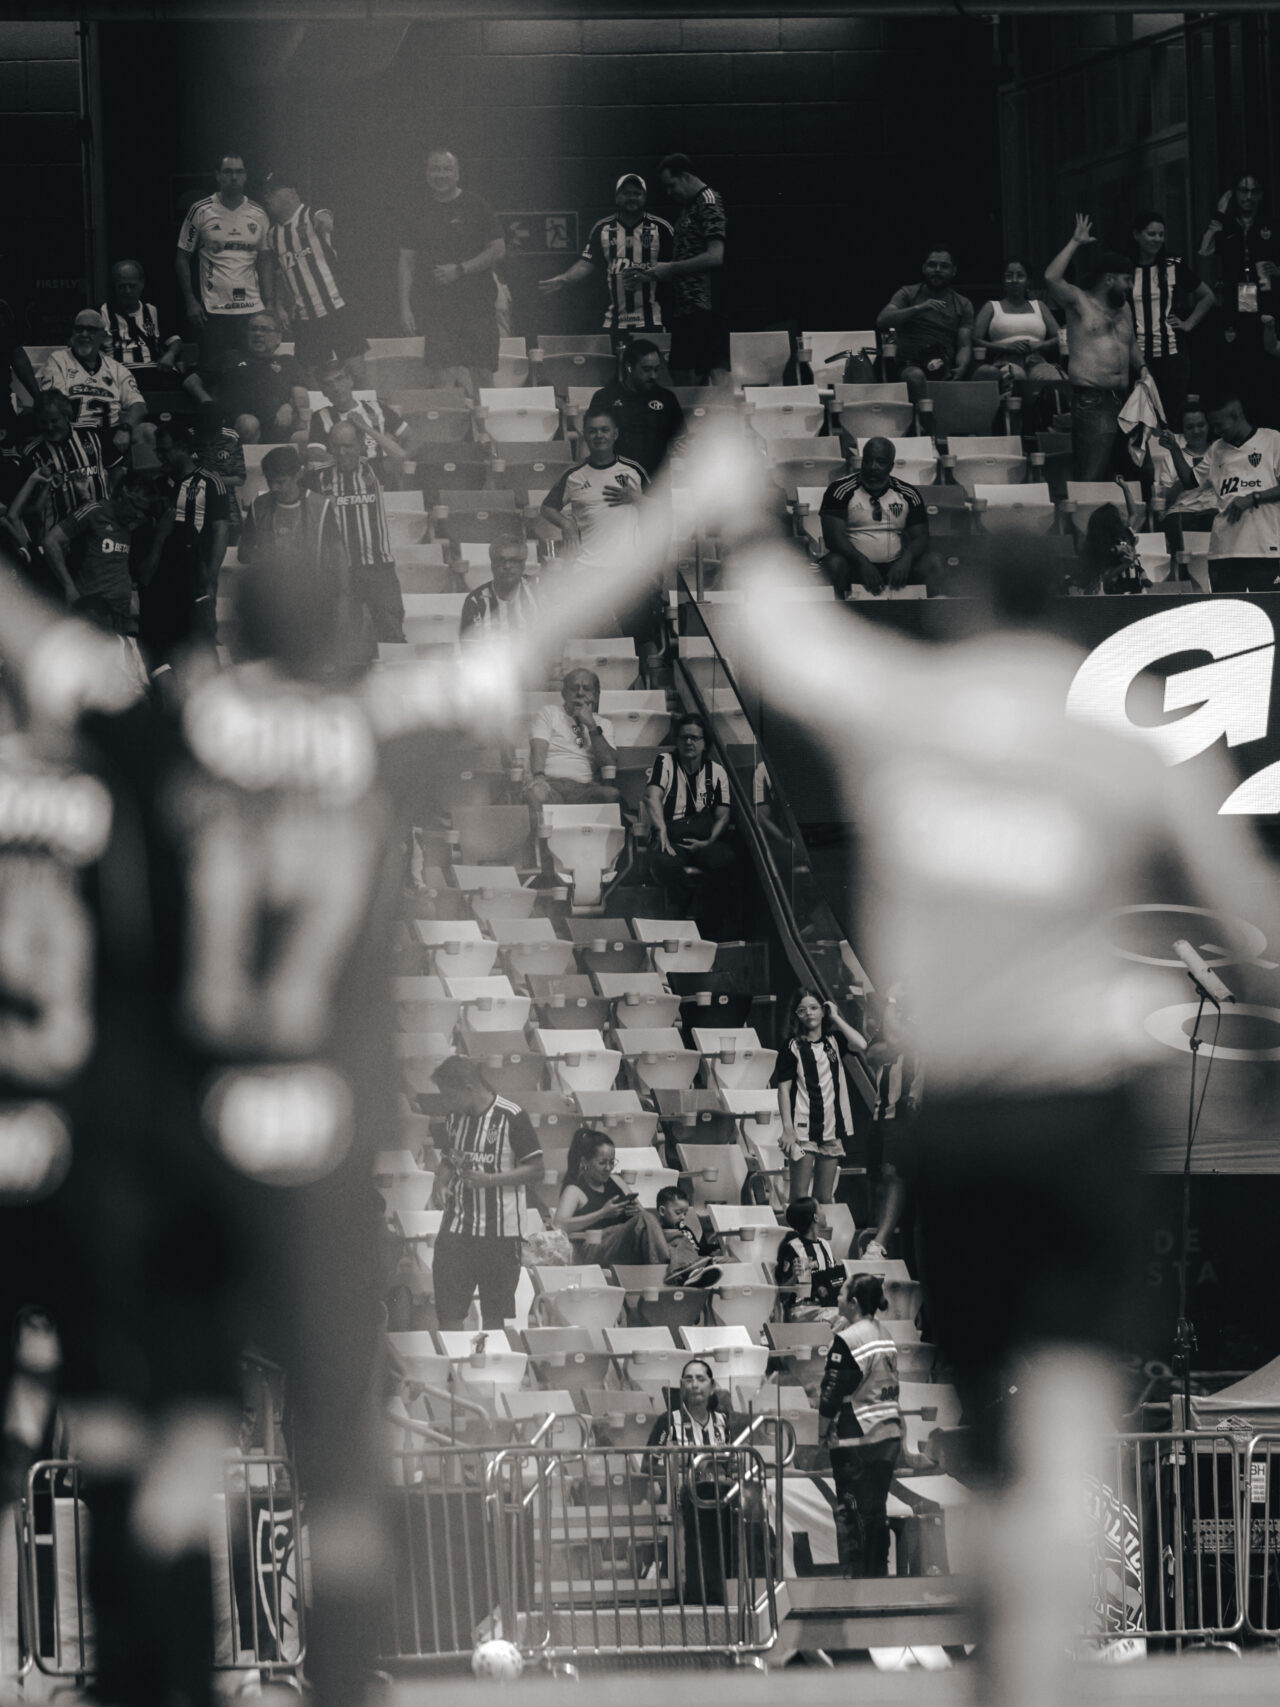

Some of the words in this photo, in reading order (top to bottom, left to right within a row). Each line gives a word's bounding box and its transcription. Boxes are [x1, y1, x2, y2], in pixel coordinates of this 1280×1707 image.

[1220, 476, 1240, 496] H2
[1240, 478, 1262, 488] bet
[336, 494, 376, 505] BETANO
